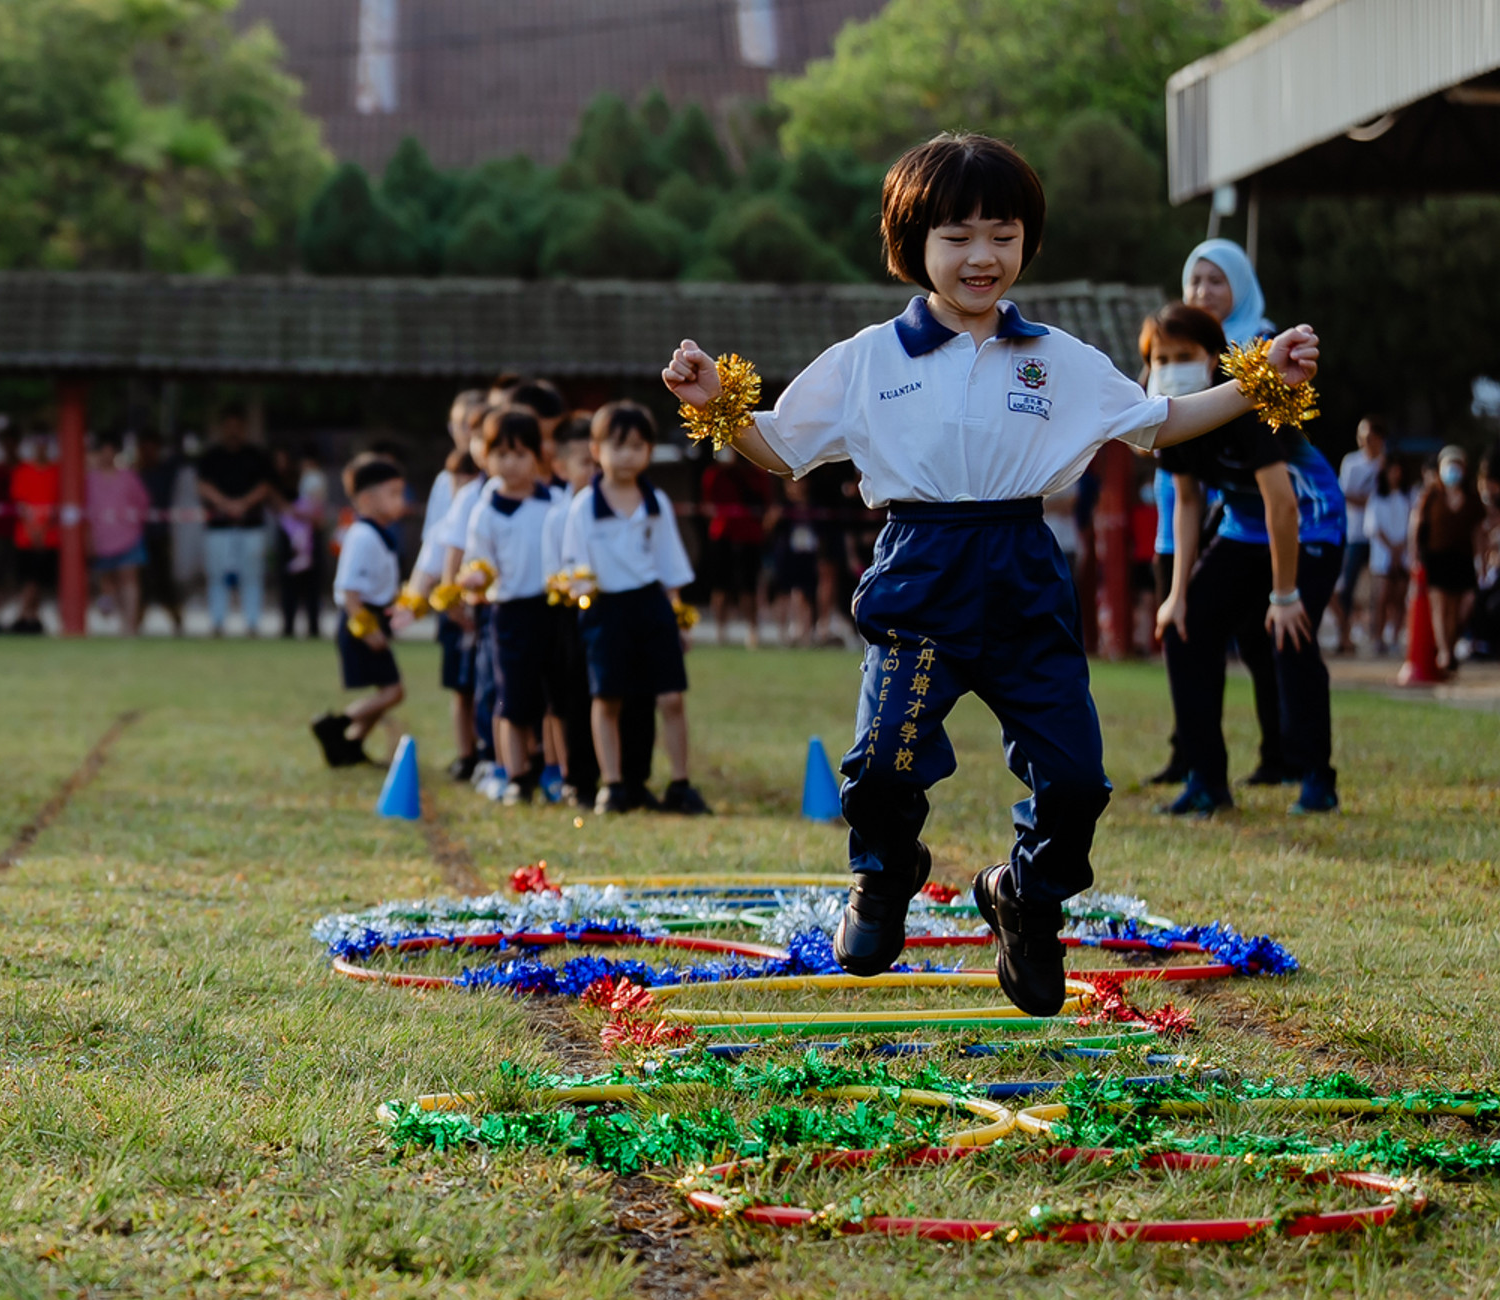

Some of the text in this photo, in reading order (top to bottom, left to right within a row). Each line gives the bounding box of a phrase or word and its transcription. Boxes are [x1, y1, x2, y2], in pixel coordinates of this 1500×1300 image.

[878, 380, 923, 401] KUANTAN
[881, 657, 900, 672] (C)
[877, 676, 892, 714] PEI
[865, 715, 883, 770] CHAI
